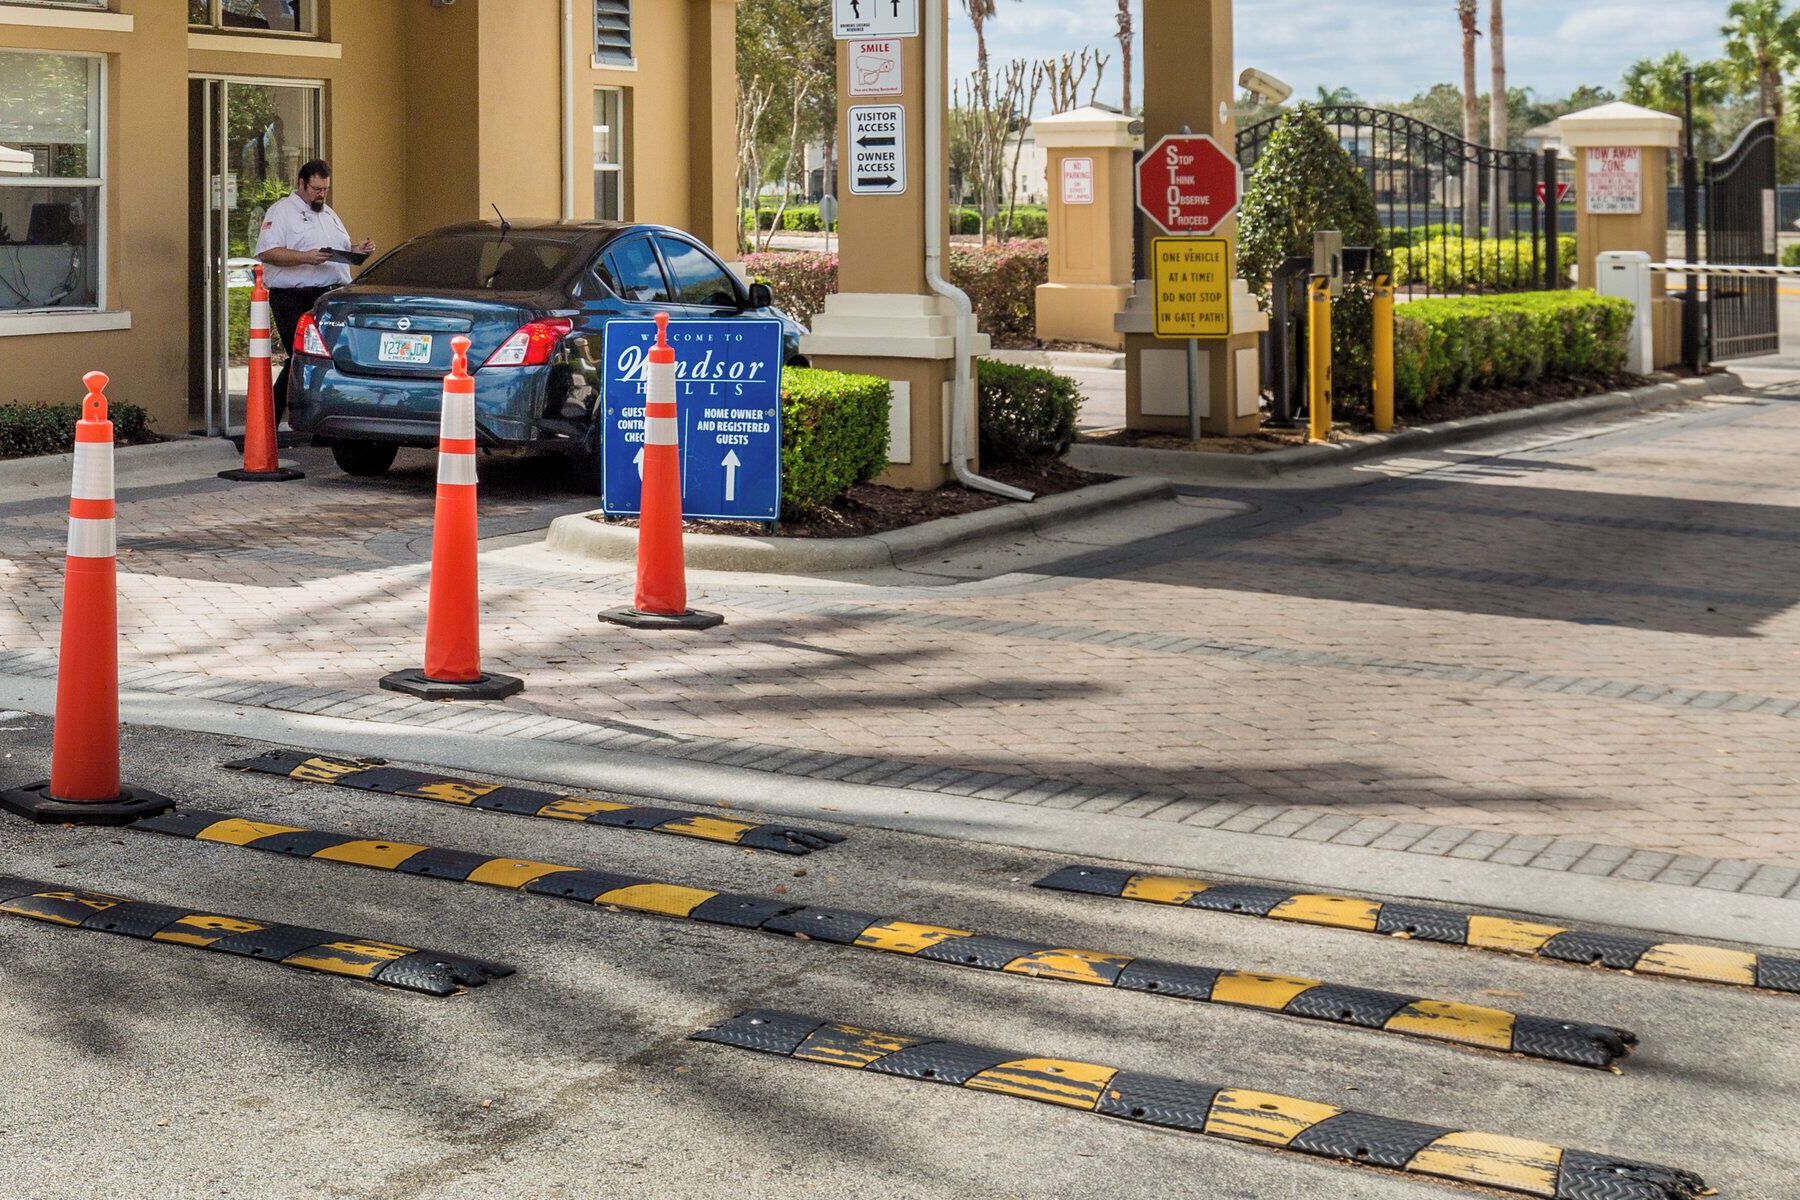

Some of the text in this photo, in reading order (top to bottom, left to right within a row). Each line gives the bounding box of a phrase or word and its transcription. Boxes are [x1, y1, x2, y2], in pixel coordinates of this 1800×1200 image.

[860, 43, 890, 53] SMILE
[856, 112, 897, 122] VISITOR
[857, 122, 896, 132] ACCESS
[857, 152, 895, 161] OWNER
[1166, 145, 1194, 165] STOP
[1590, 147, 1639, 160] TOW AWAY
[857, 163, 896, 172] ACCESS
[1601, 159, 1625, 172] ZONE
[1162, 252, 1220, 262] ONE VEHICLE
[1168, 272, 1214, 282] AT A TIME!
[1163, 292, 1222, 302] DO NOT STOP
[1161, 312, 1224, 322] IN GATE PATH!
[617, 345, 764, 382] Wndsor
[636, 382, 743, 396] HLLS
[704, 408, 763, 420] HOME OWNER
[697, 421, 770, 434] AND REGISTERED
[624, 432, 645, 442] CHEC
[716, 434, 749, 445] GUESTS
